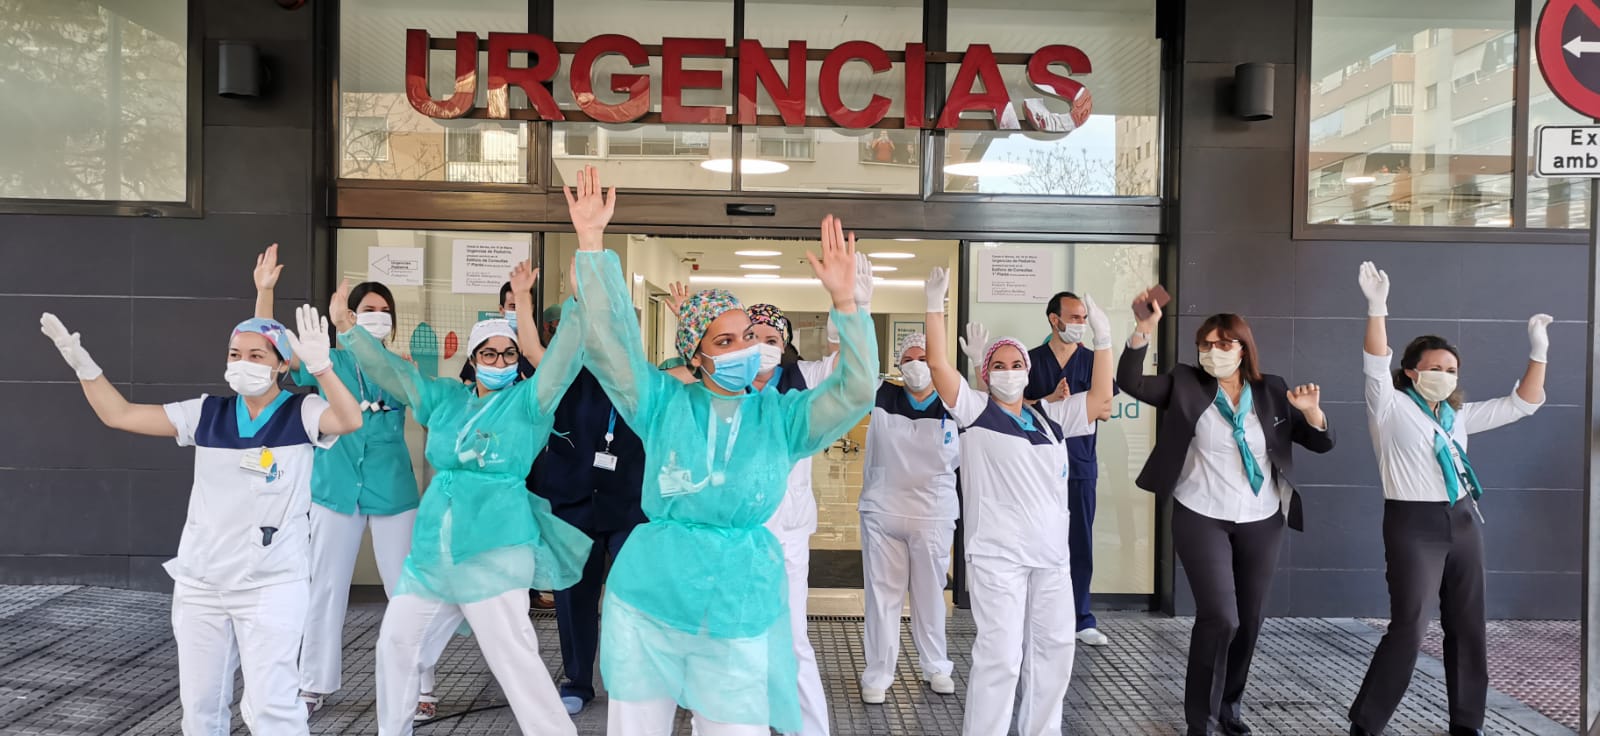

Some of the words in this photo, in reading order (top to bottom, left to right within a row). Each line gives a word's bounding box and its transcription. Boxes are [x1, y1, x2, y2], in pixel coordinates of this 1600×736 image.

[405, 28, 1093, 133] URGENCIAS
[1571, 129, 1598, 146] Ex
[1553, 152, 1598, 169] amb
